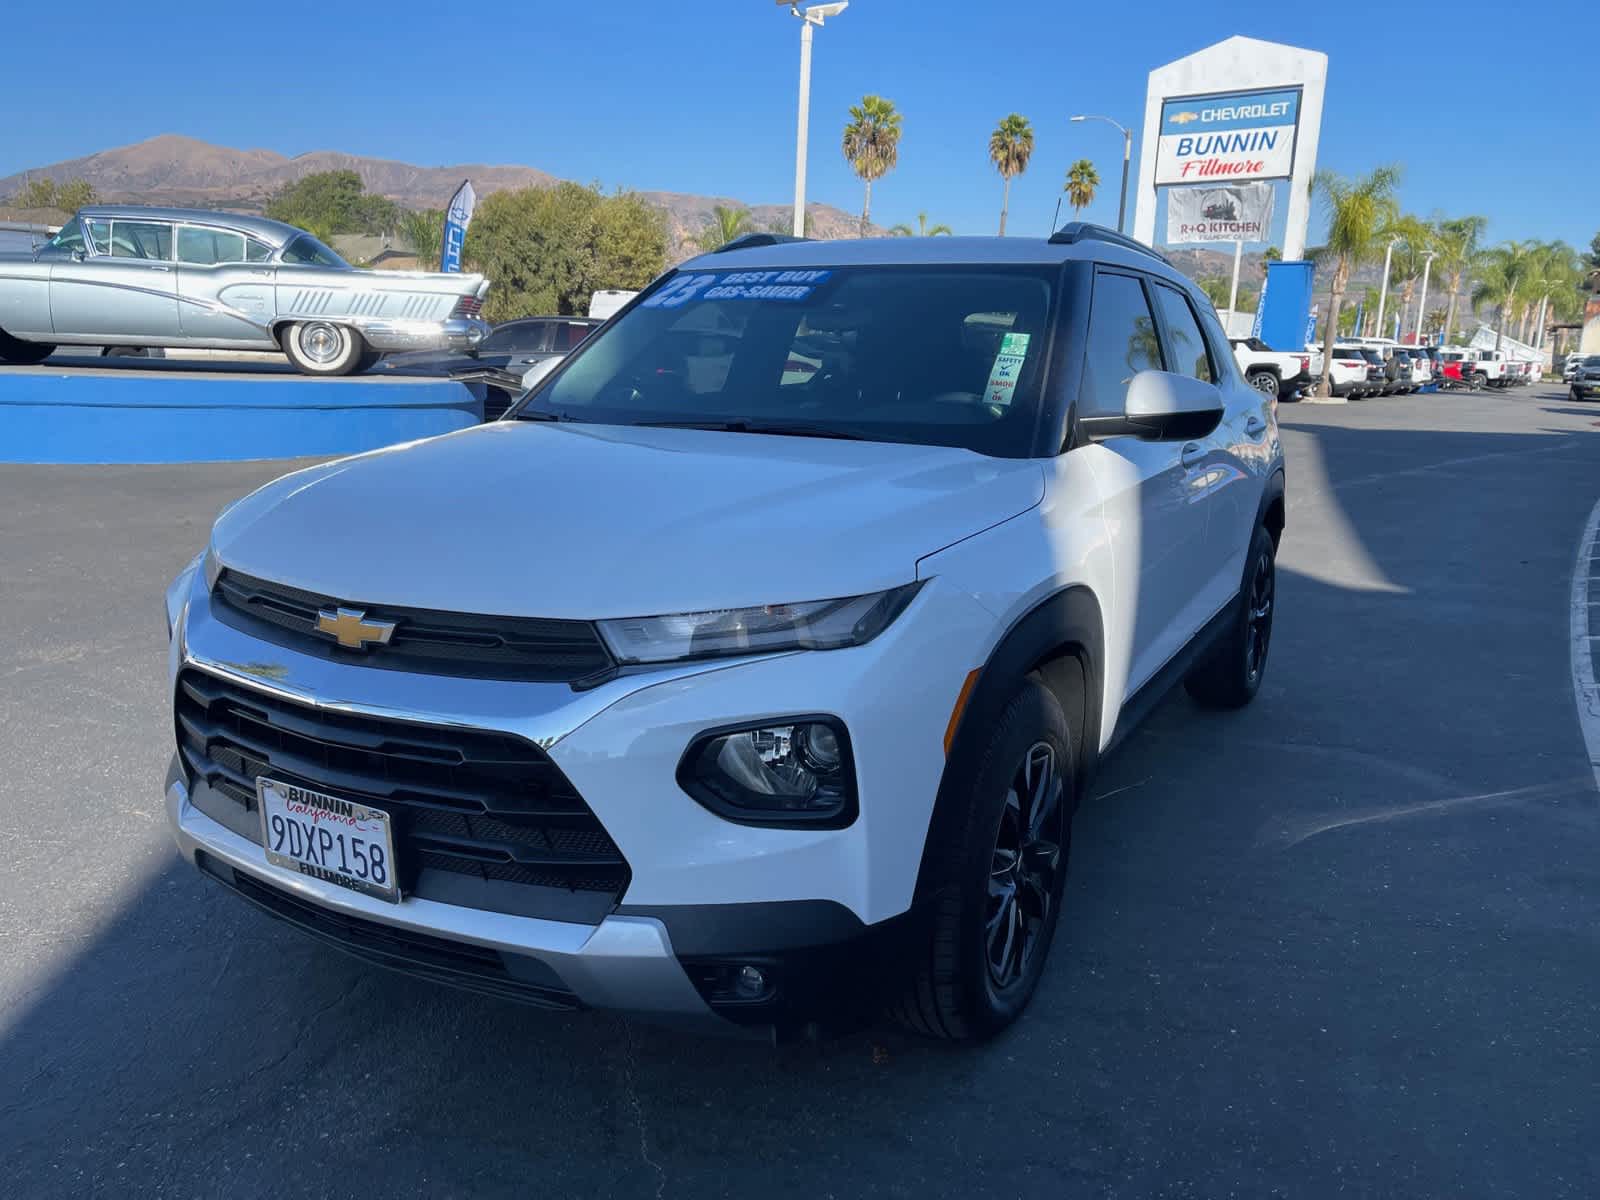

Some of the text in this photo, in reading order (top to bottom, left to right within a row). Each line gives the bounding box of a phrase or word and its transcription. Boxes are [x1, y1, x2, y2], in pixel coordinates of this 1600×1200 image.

[1201, 102, 1290, 122] CHEVROLET
[1176, 130, 1278, 157] BUNNIN
[1180, 158, 1265, 177] Fillmore
[1209, 222, 1261, 233] KITCHEN
[720, 271, 830, 284] BEST BUY
[704, 286, 811, 299] GAS-SAVER
[286, 799, 357, 826] California
[289, 788, 353, 817] BUNNIN
[272, 815, 386, 884] 9DXP158
[299, 862, 361, 890] FILLMORE
